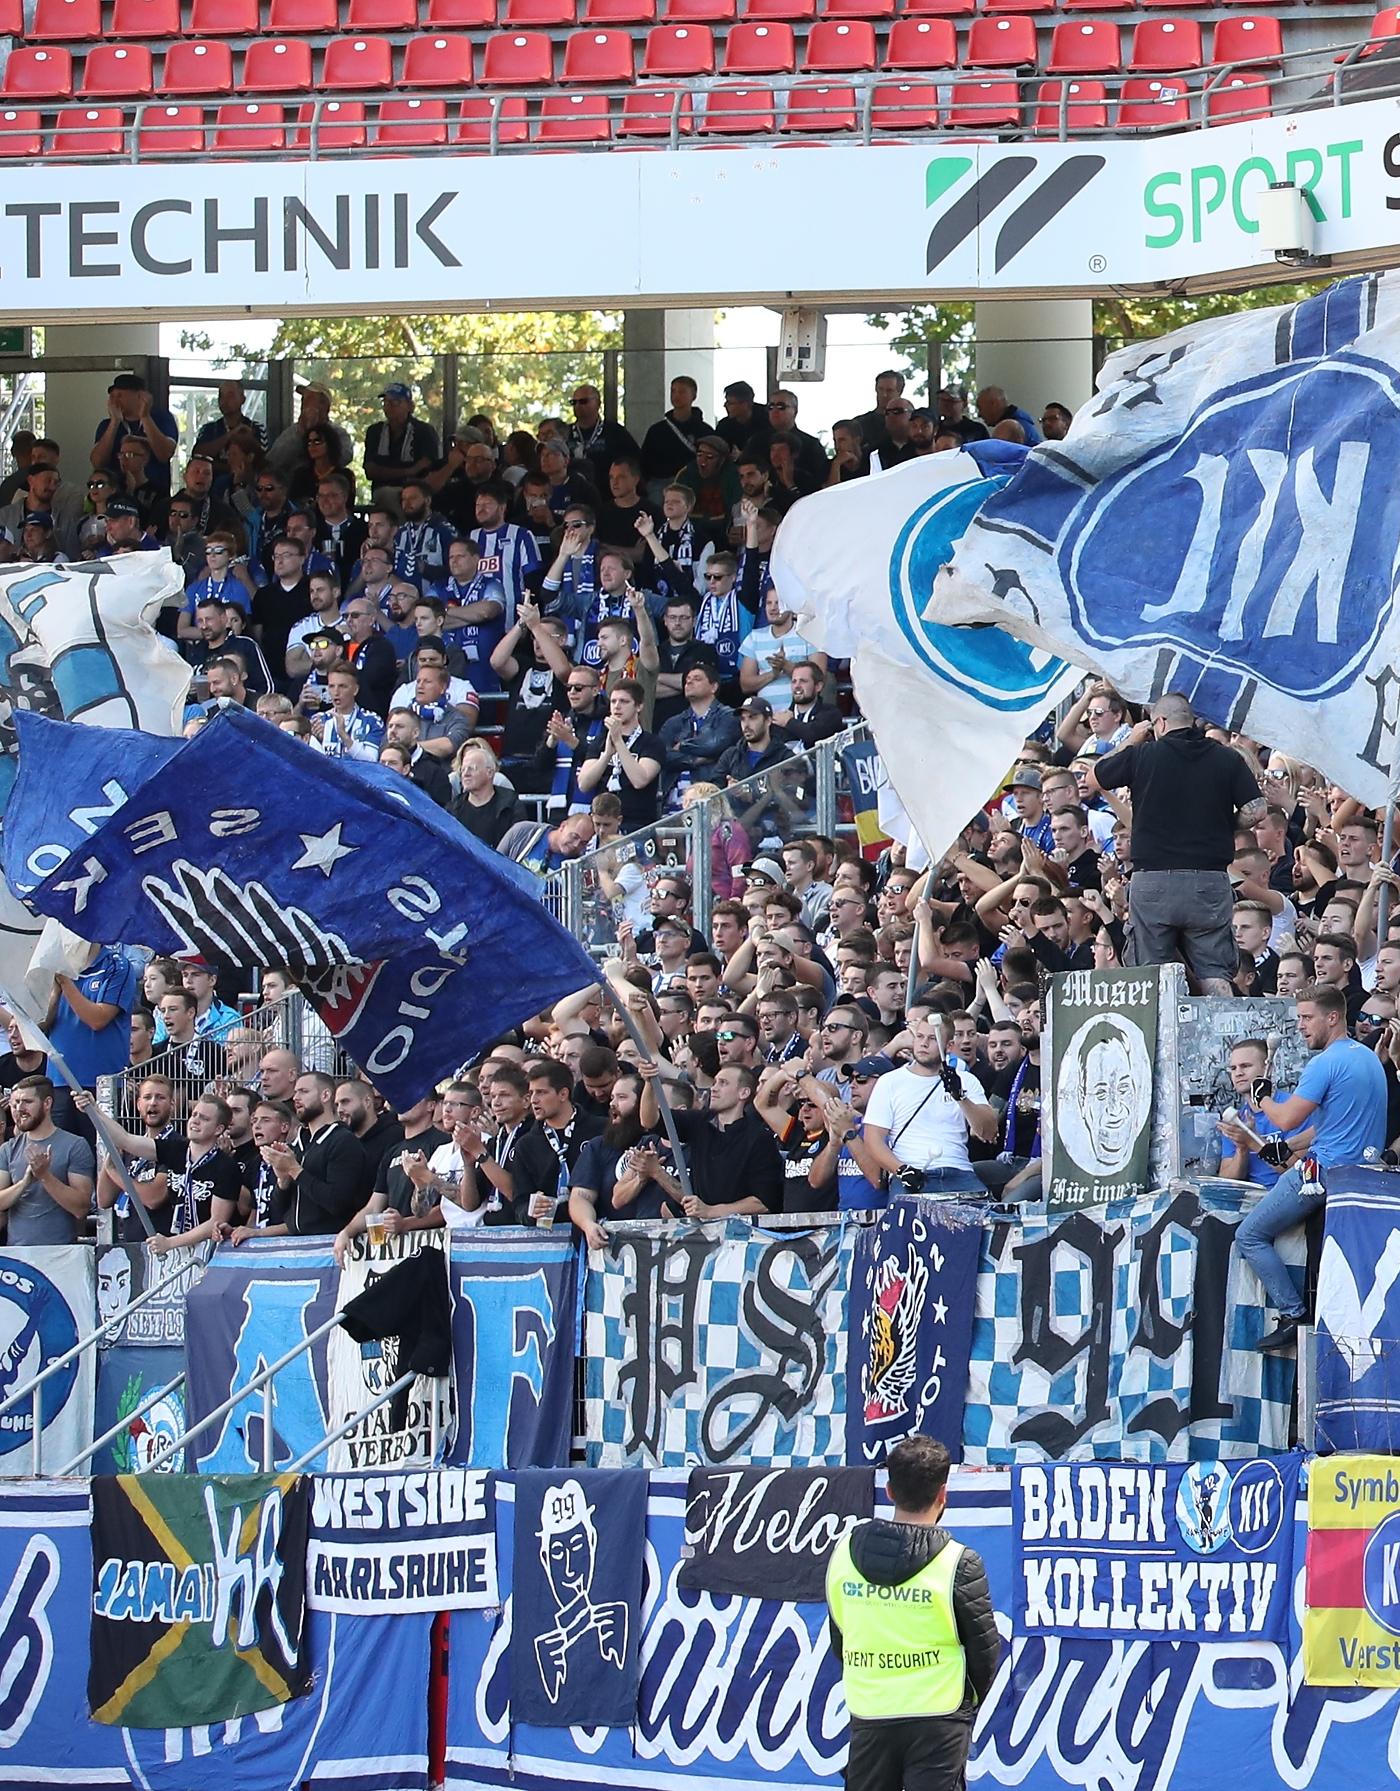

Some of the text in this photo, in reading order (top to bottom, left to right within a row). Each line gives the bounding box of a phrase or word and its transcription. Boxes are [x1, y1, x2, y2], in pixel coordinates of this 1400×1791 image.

[4, 191, 464, 279] TECHNIK
[1060, 970, 1154, 1008] Moser
[313, 1470, 488, 1530] WESTSIDE
[1019, 1464, 1167, 1542] BADEN
[315, 1548, 488, 1600] KARLSRUHE
[866, 1583, 934, 1604] POWER
[1023, 1558, 1279, 1634] KOLLEKTIV
[878, 1649, 941, 1669] SECURITY
